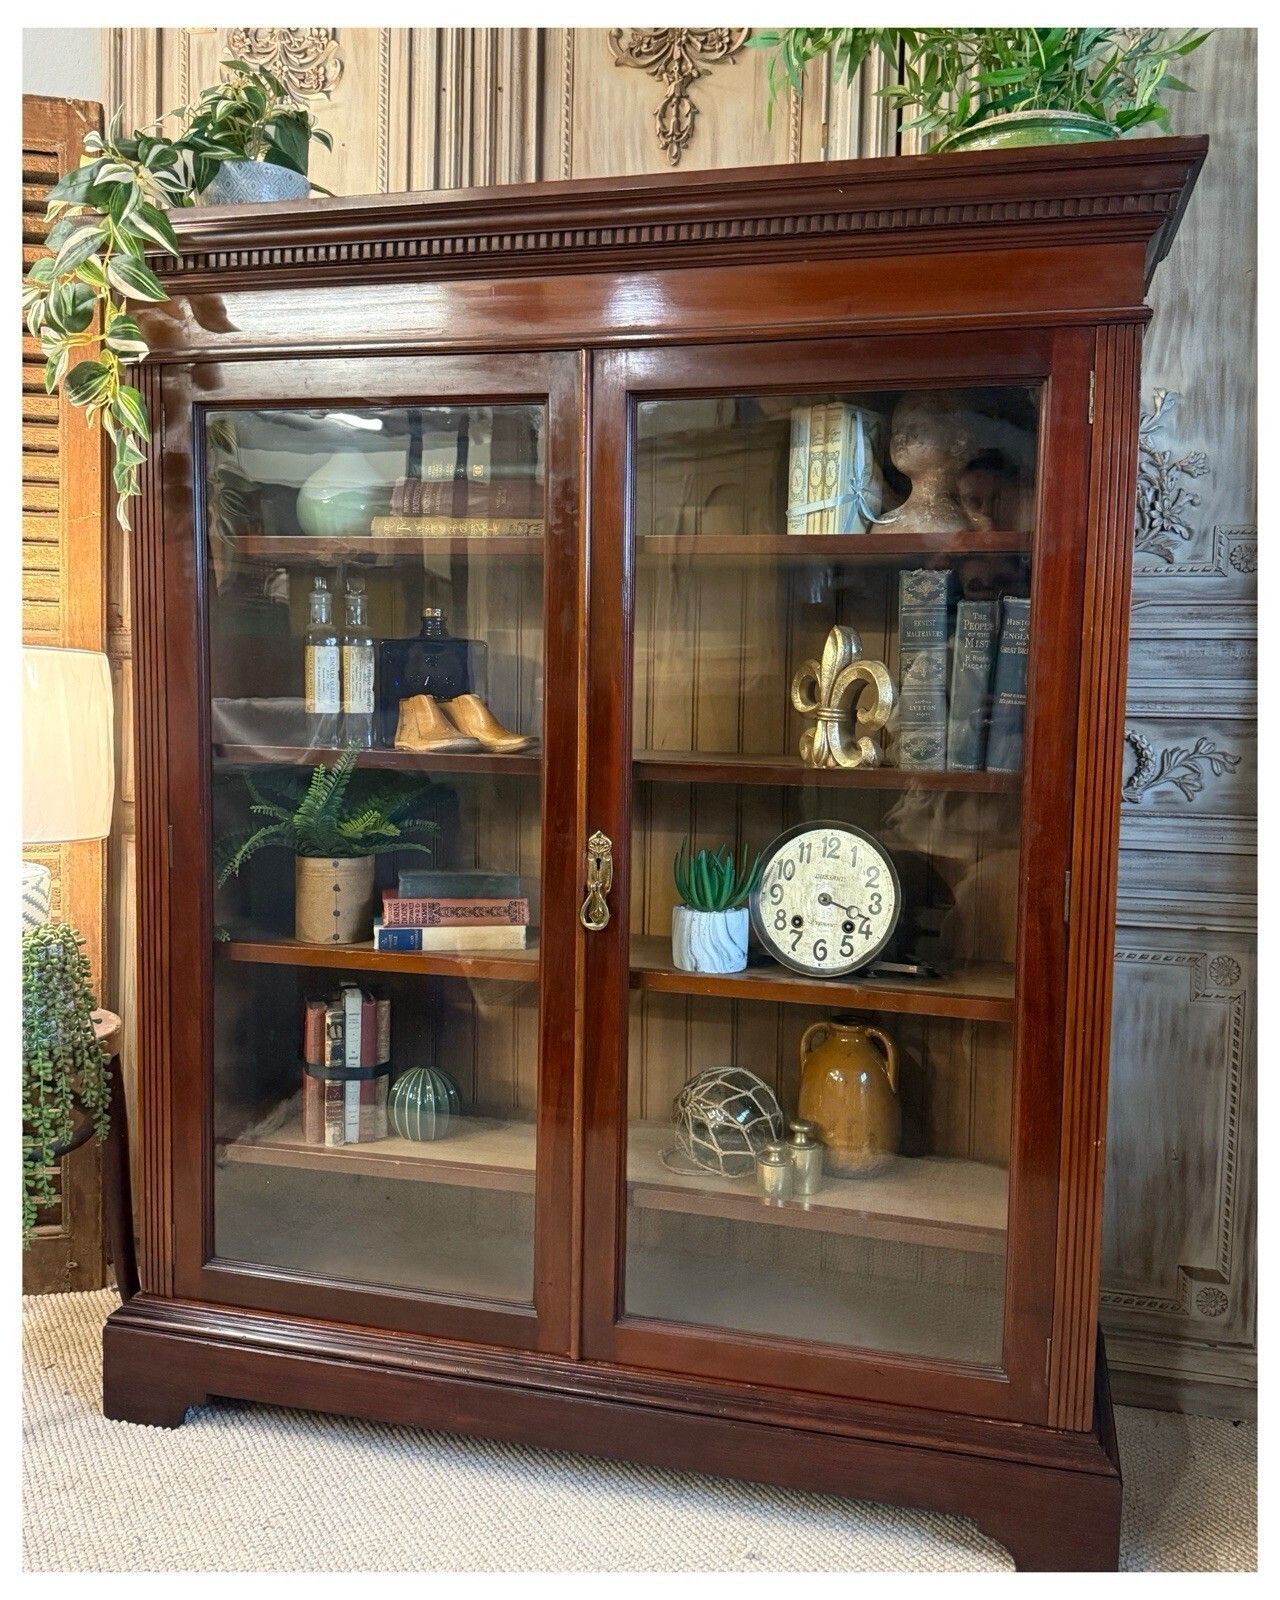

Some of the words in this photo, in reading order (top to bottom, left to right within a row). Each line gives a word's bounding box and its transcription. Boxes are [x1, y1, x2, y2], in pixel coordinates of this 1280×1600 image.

[1006, 618, 1031, 626] HISTO
[1003, 630, 1030, 640] ENGLA
[798, 841, 813, 864] 11
[821, 836, 842, 860] 12
[850, 845, 858, 868] 1
[777, 858, 796, 881] 10
[865, 865, 880, 889] 2
[769, 883, 784, 906] 9
[868, 892, 882, 915] 3
[774, 908, 787, 931] 8
[857, 916, 873, 940] 4
[789, 929, 804, 952] 7
[813, 938, 828, 962] 6
[839, 935, 854, 958] 5
